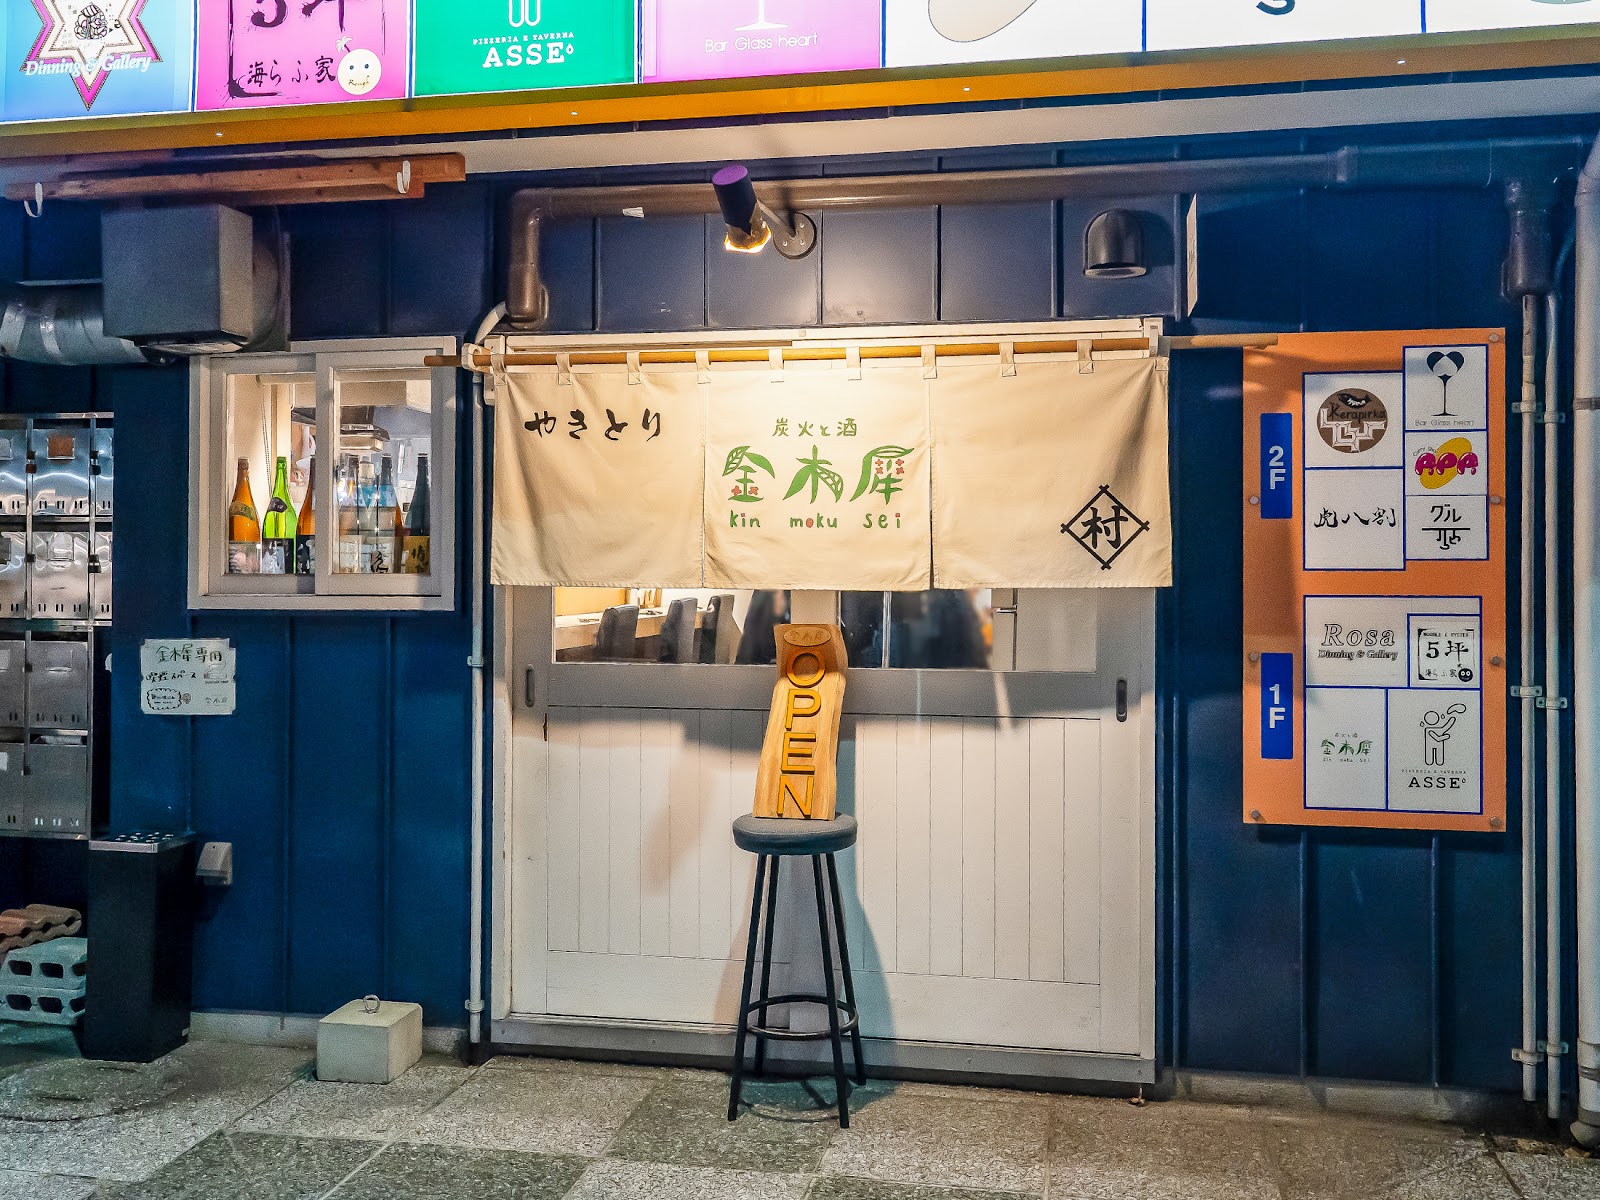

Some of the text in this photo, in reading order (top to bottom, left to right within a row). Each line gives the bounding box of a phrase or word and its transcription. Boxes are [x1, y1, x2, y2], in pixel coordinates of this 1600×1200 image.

[472, 31, 575, 46] PIZZERIA E TAVERNA
[704, 32, 818, 53] Bar Glass heart
[25, 53, 152, 78] Dinning & Gallery
[247, 55, 337, 87] 海らふ家
[524, 408, 662, 441] やきとり
[771, 417, 858, 438] 炭火と酒
[721, 444, 915, 505] 金木犀
[729, 510, 902, 529] kin moku sei
[1431, 503, 1463, 523] グル
[1080, 505, 1129, 550] 村
[1320, 623, 1396, 647] Rosa
[1317, 649, 1399, 662] Dinning & Gallery
[777, 651, 826, 818] OPEN
